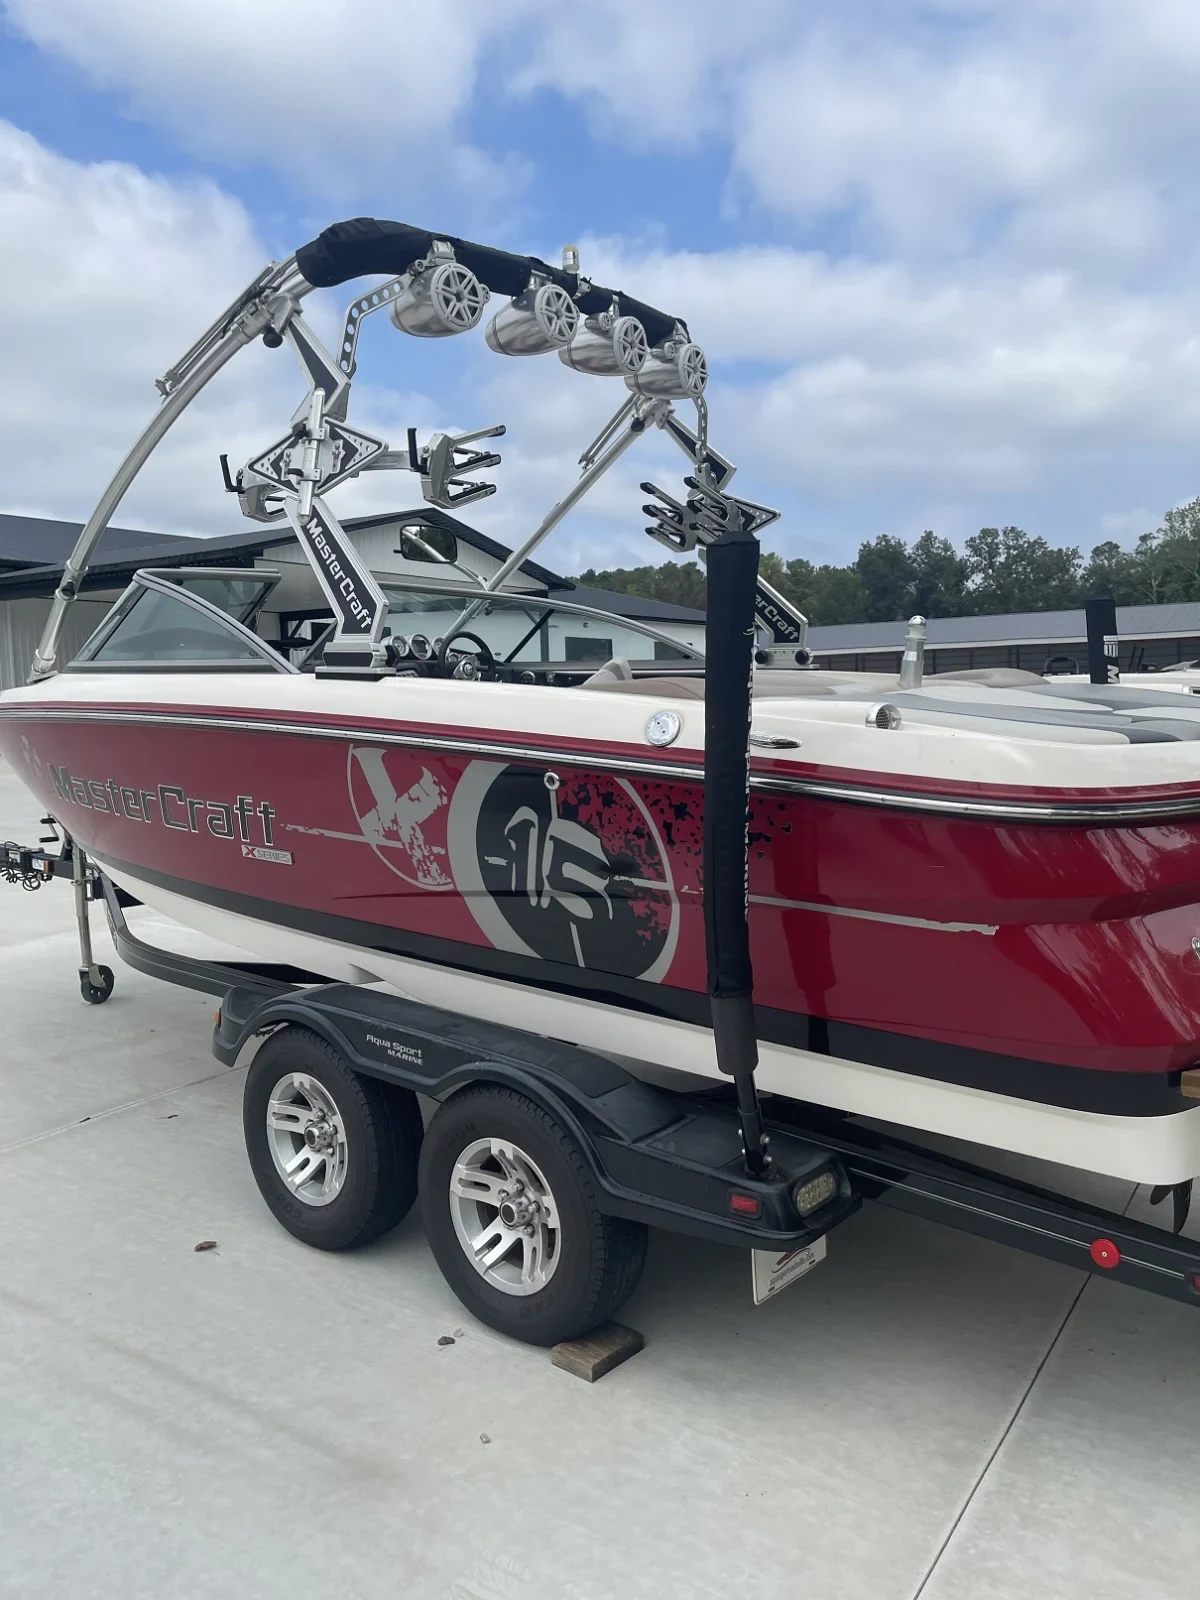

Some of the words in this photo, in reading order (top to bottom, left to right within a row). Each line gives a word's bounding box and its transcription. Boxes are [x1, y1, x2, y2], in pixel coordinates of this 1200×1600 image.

[306, 517, 372, 629] MasterCraft
[47, 763, 275, 846] MasterCraft
[366, 1034, 391, 1048] Aqua
[392, 1042, 422, 1058] Sport
[387, 1049, 423, 1066] MARINE
